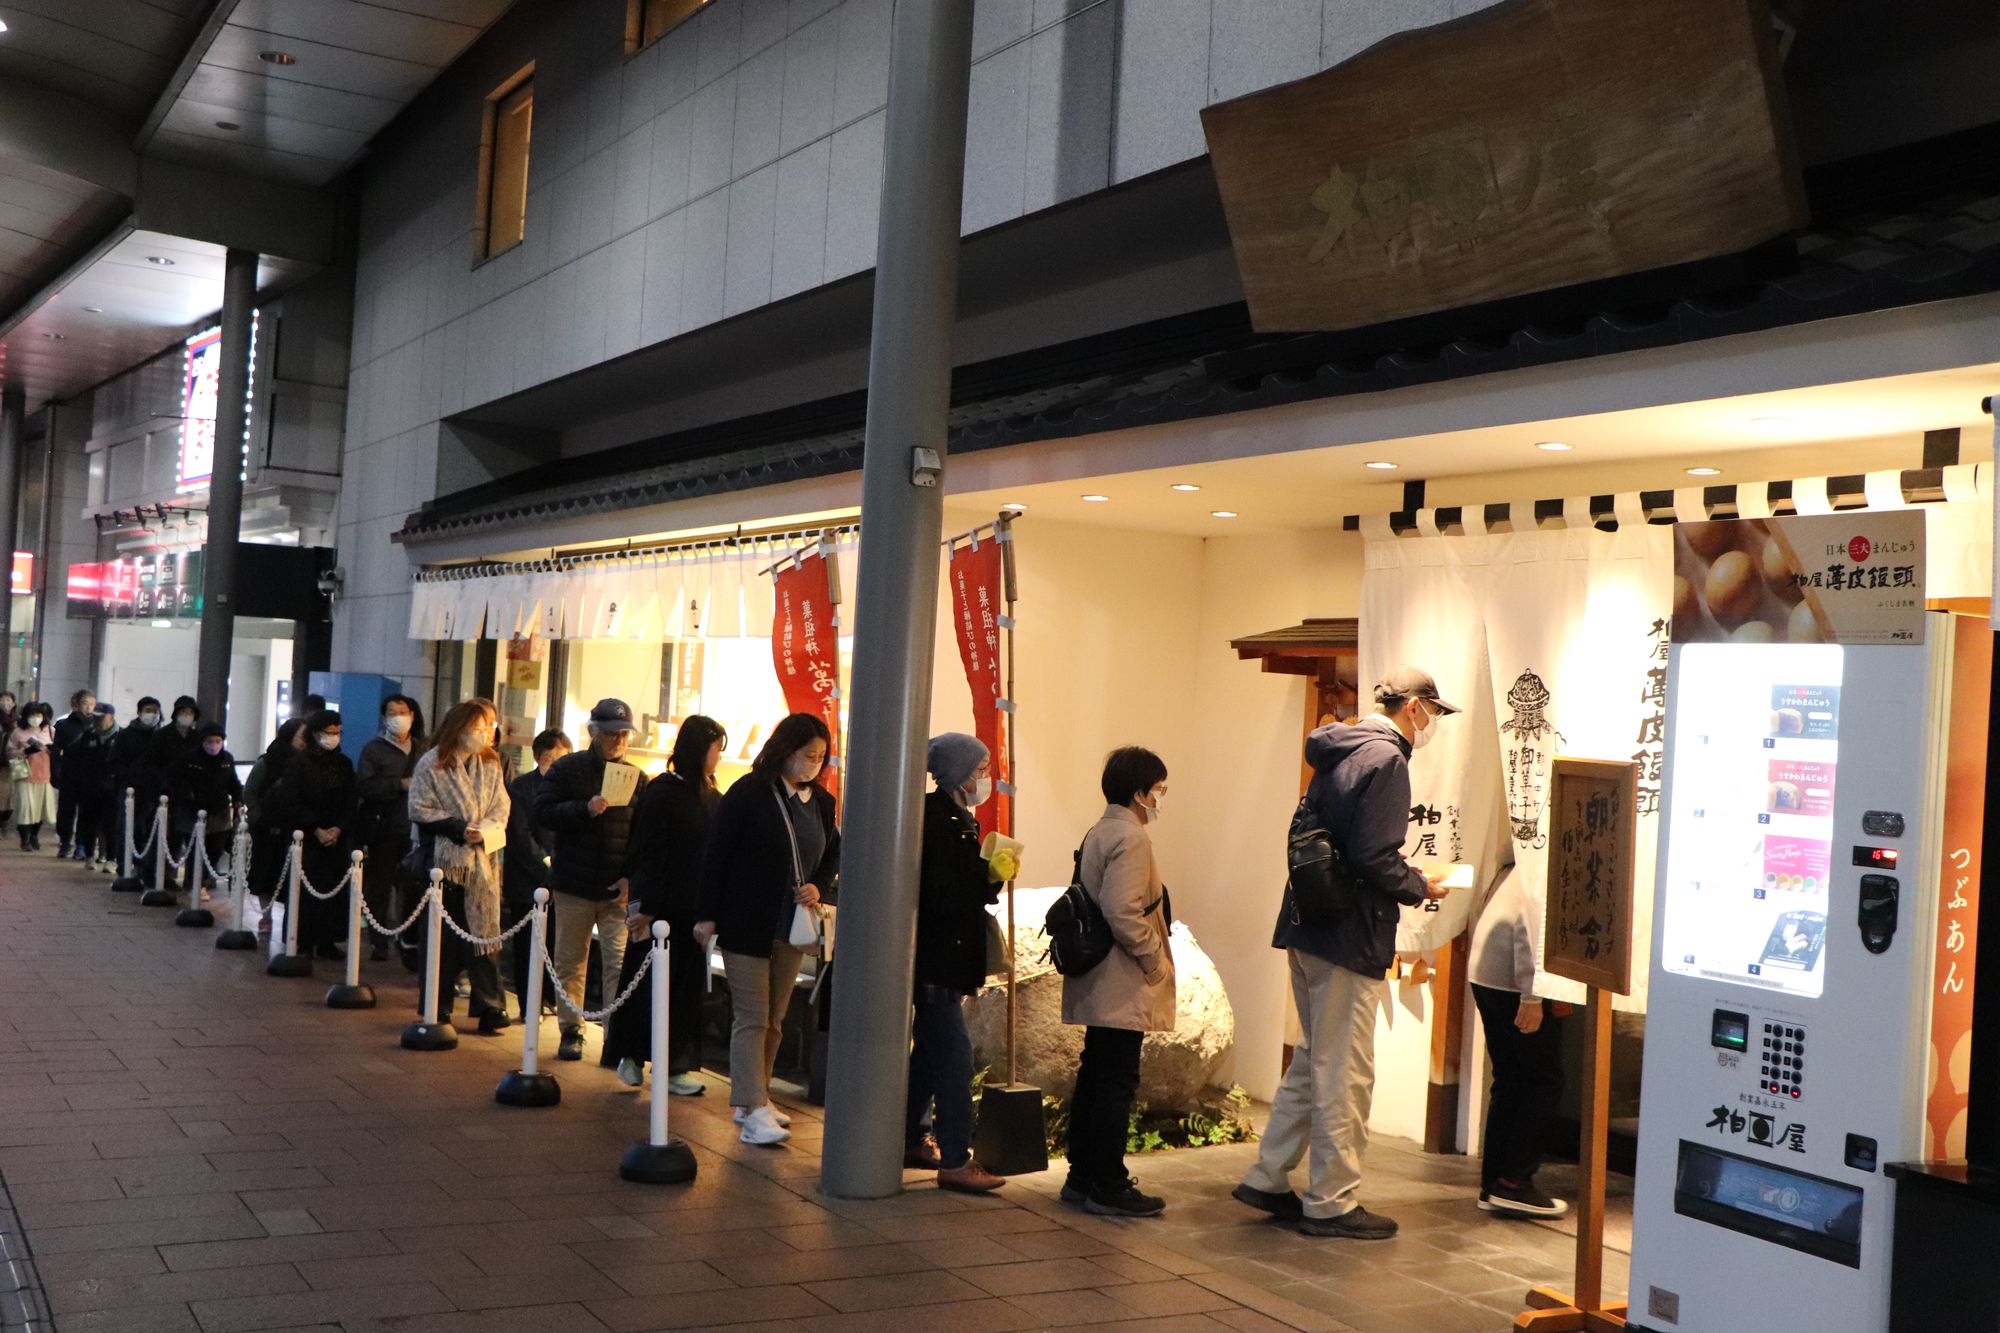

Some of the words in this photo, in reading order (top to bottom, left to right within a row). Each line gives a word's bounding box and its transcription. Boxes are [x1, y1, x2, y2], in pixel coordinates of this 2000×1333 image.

[1826, 540, 1916, 557] 日本三大まんじゅう
[1447, 805, 1463, 864] 創業嘉永五
[1942, 848, 1971, 994] つぶあん
